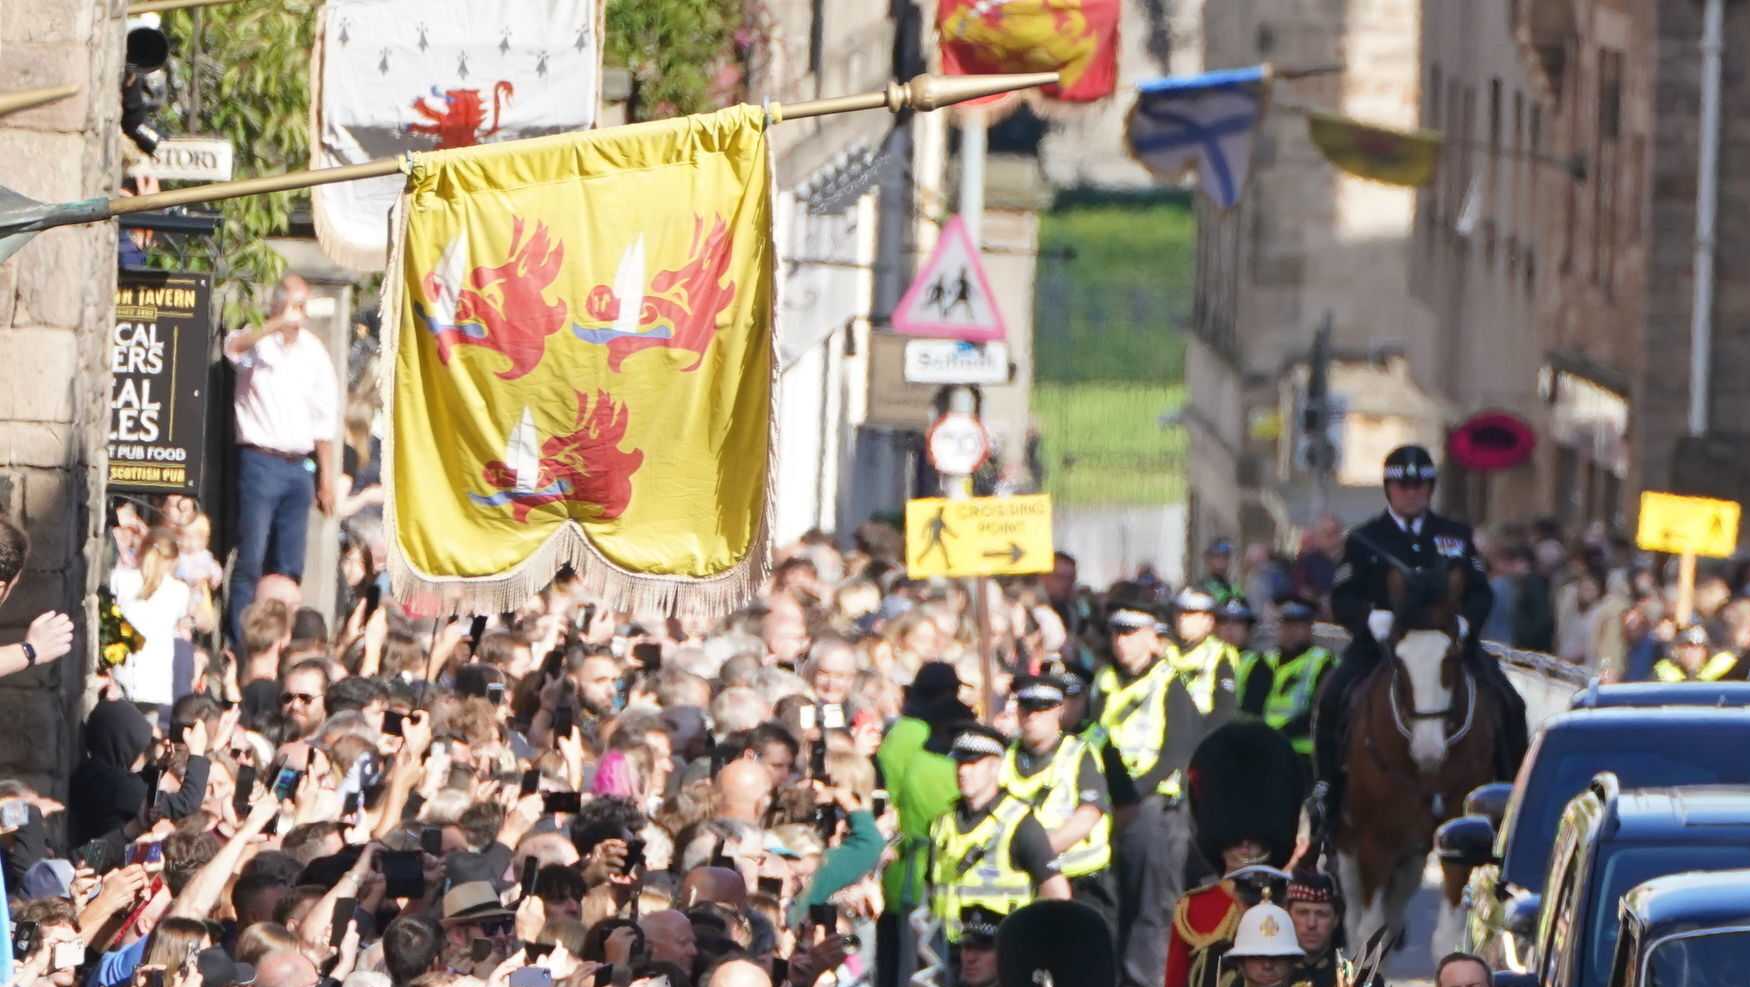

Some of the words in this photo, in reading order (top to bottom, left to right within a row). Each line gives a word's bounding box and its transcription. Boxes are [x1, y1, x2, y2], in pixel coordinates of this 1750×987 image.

[139, 287, 195, 307] TAVERN
[111, 378, 161, 410] AL
[147, 446, 186, 461] FOOD
[957, 500, 1045, 519] CROSSING
[977, 520, 1025, 535] POINT
